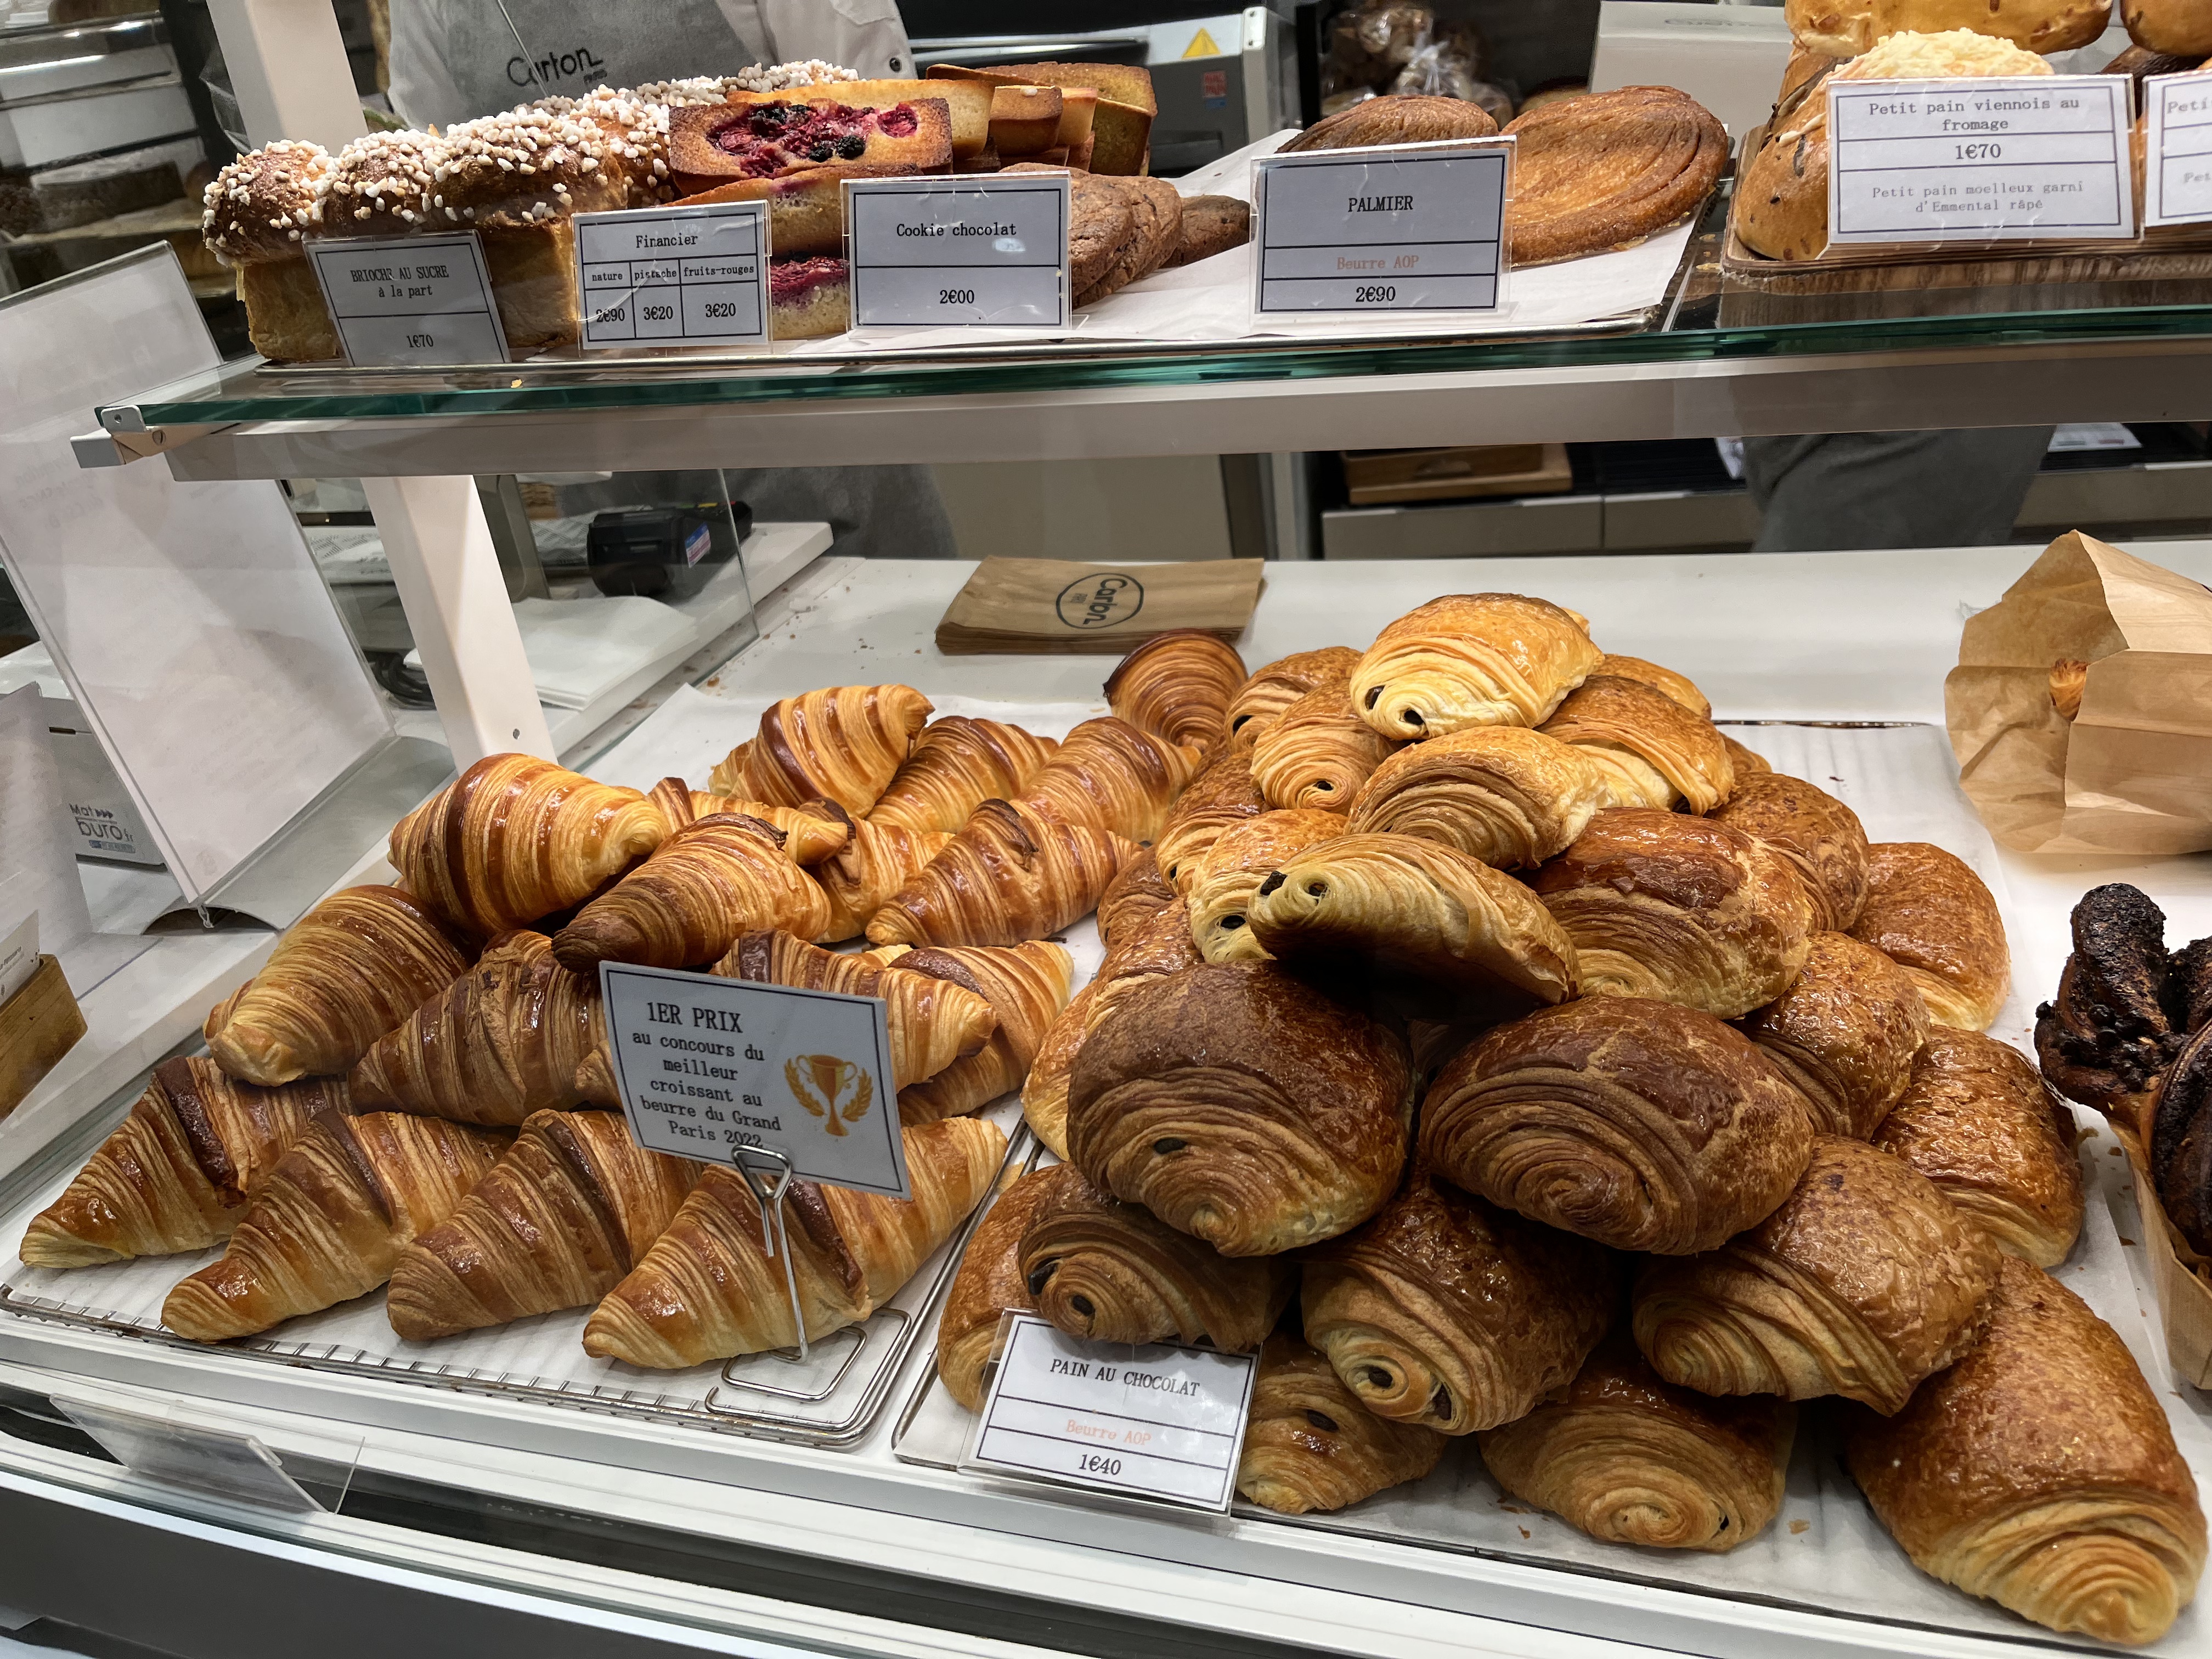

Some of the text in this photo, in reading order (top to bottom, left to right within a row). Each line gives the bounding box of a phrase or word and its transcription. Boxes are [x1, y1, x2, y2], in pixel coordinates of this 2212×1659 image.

[1870, 97, 2080, 115] Petit pain viennois au
[2167, 97, 2212, 114] Peti
[1942, 119, 2009, 132] fromage
[1955, 143, 2001, 160] 1€70
[1872, 181, 2083, 198] Petit pain moelleux garni
[1348, 195, 1414, 212] PALMIER
[2010, 200, 2044, 211] râpé
[896, 222, 1017, 237] Cookie chocolat
[636, 233, 698, 248] Financier
[1337, 255, 1419, 270] Beurre AOP
[350, 266, 449, 282] BRIOCHE AU SUCRE
[592, 272, 623, 281] nature
[634, 269, 677, 280] pistache
[684, 266, 754, 277] fruits-rouges
[379, 285, 433, 298] à la part
[939, 289, 975, 304] 2€00
[1356, 286, 1396, 302] 2€90
[596, 308, 625, 323] 2€90
[644, 306, 674, 320] 3€20
[705, 303, 736, 318] 3€20
[407, 334, 434, 348] 1€70
[69, 803, 93, 816] Mat
[647, 1001, 743, 1034] 1ER PRIX
[632, 1031, 765, 1061] au concours du
[663, 1058, 738, 1080] meilleur
[651, 1078, 763, 1107] croissant au
[640, 1095, 782, 1131] beurre du Grand
[668, 1120, 763, 1148] Paris 2022
[1049, 1358, 1200, 1397] PAIN AU CHOCOLAT
[1066, 1419, 1152, 1445] Beurre AOP
[1079, 1454, 1121, 1476] 1€40
